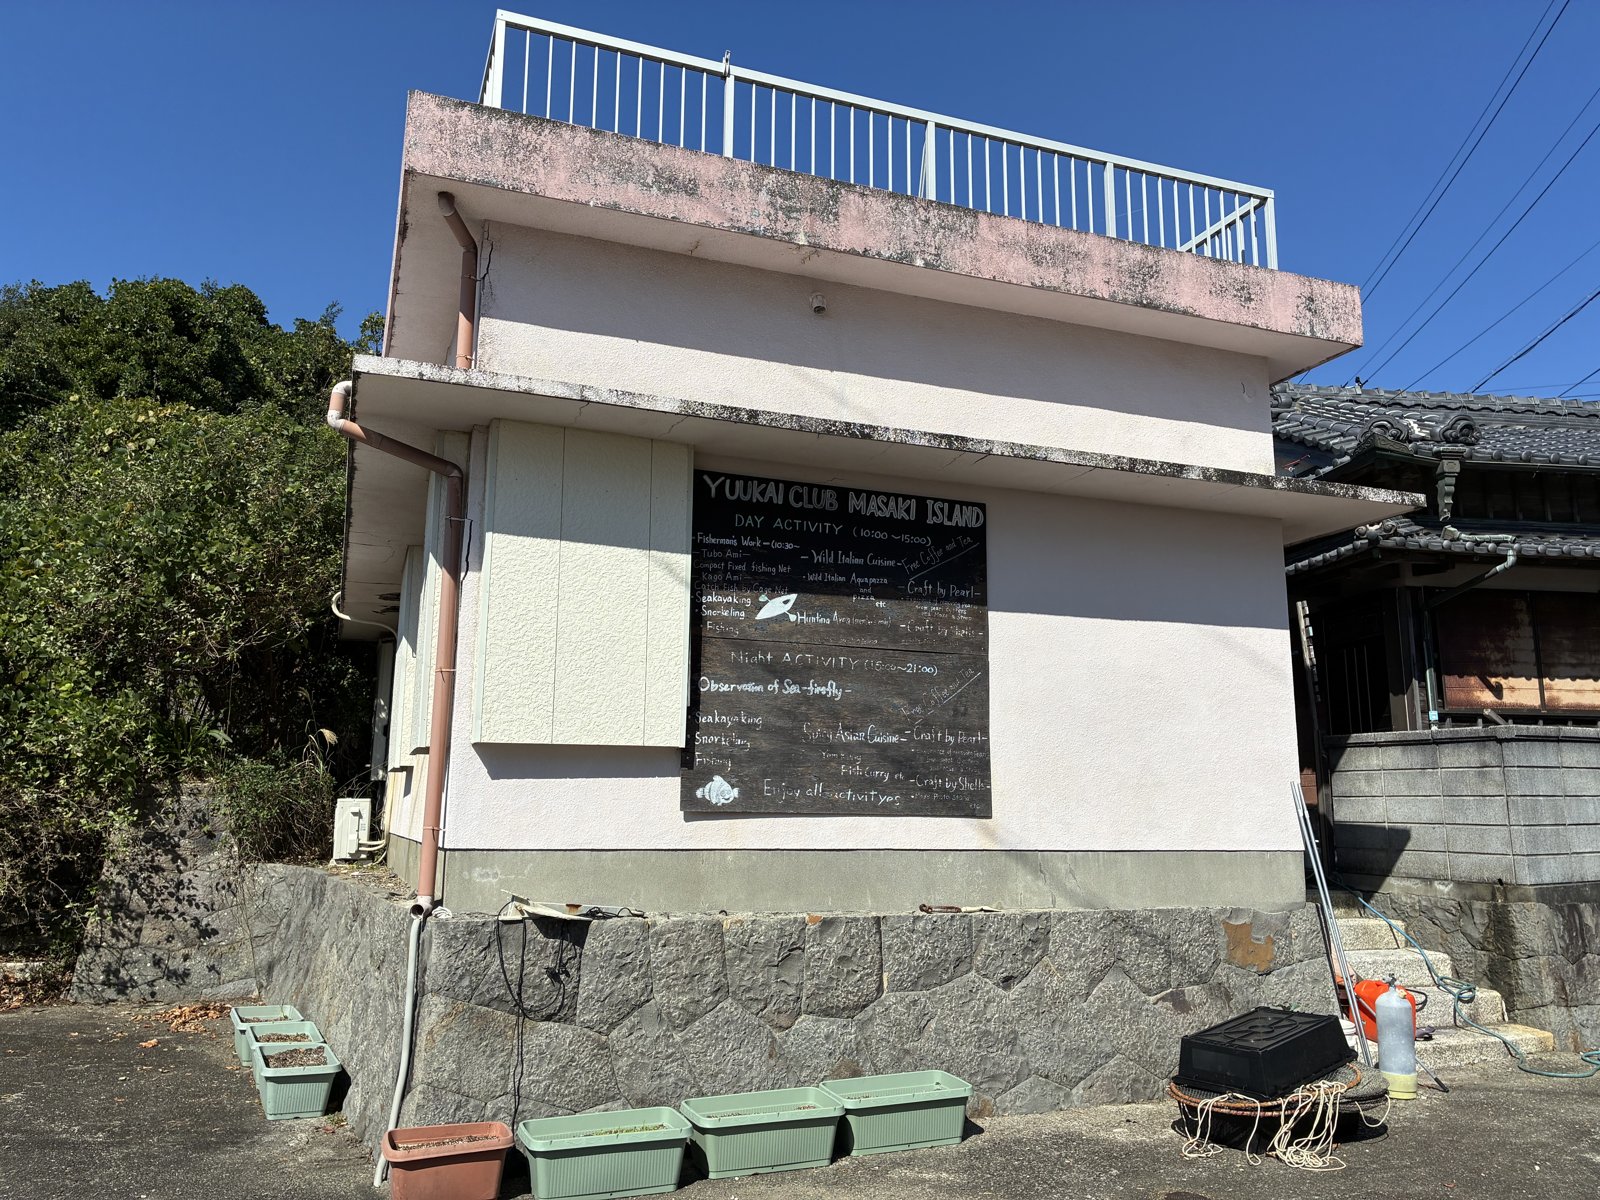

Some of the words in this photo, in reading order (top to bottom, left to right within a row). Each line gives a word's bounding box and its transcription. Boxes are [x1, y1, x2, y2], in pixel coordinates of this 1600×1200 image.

[703, 474, 785, 505] YUUKAI
[788, 485, 839, 511] CLUB
[848, 491, 917, 521] MASAKI
[926, 499, 985, 528] ISLAND
[735, 513, 765, 529] DAY
[772, 517, 844, 535] ACTIVITY
[741, 535, 762, 548] Work
[956, 534, 974, 548] Tea
[701, 548, 723, 559] Tubo
[725, 549, 742, 560] Ami
[810, 549, 835, 565] Wild
[838, 551, 864, 566] Italian
[866, 552, 897, 568] Cuisine
[701, 571, 723, 582] Kago
[907, 579, 933, 597] Craft
[937, 581, 946, 598] by
[949, 584, 975, 599] Pearl
[699, 675, 764, 693] Observation
[767, 678, 780, 695] of
[866, 724, 900, 744] Cuisine
[945, 728, 955, 746] by
